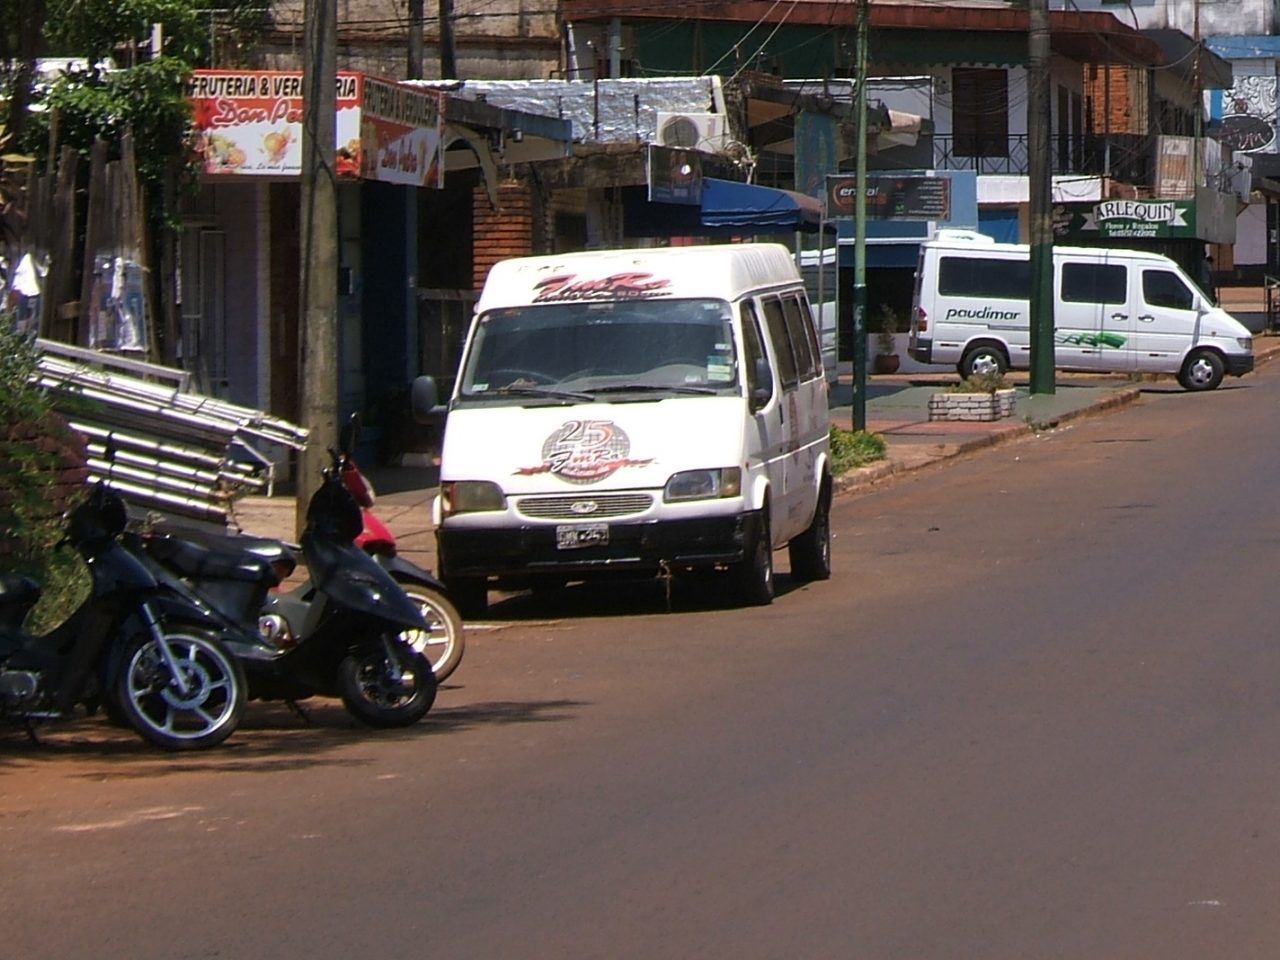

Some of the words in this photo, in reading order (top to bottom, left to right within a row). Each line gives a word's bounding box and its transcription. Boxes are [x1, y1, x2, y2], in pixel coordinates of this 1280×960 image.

[193, 76, 256, 96] FRUTERIA
[260, 77, 270, 96] &
[213, 98, 266, 125] Don
[1095, 201, 1174, 221] ARLEQUIN
[946, 307, 1021, 320] paudimar
[558, 419, 614, 448] 25
